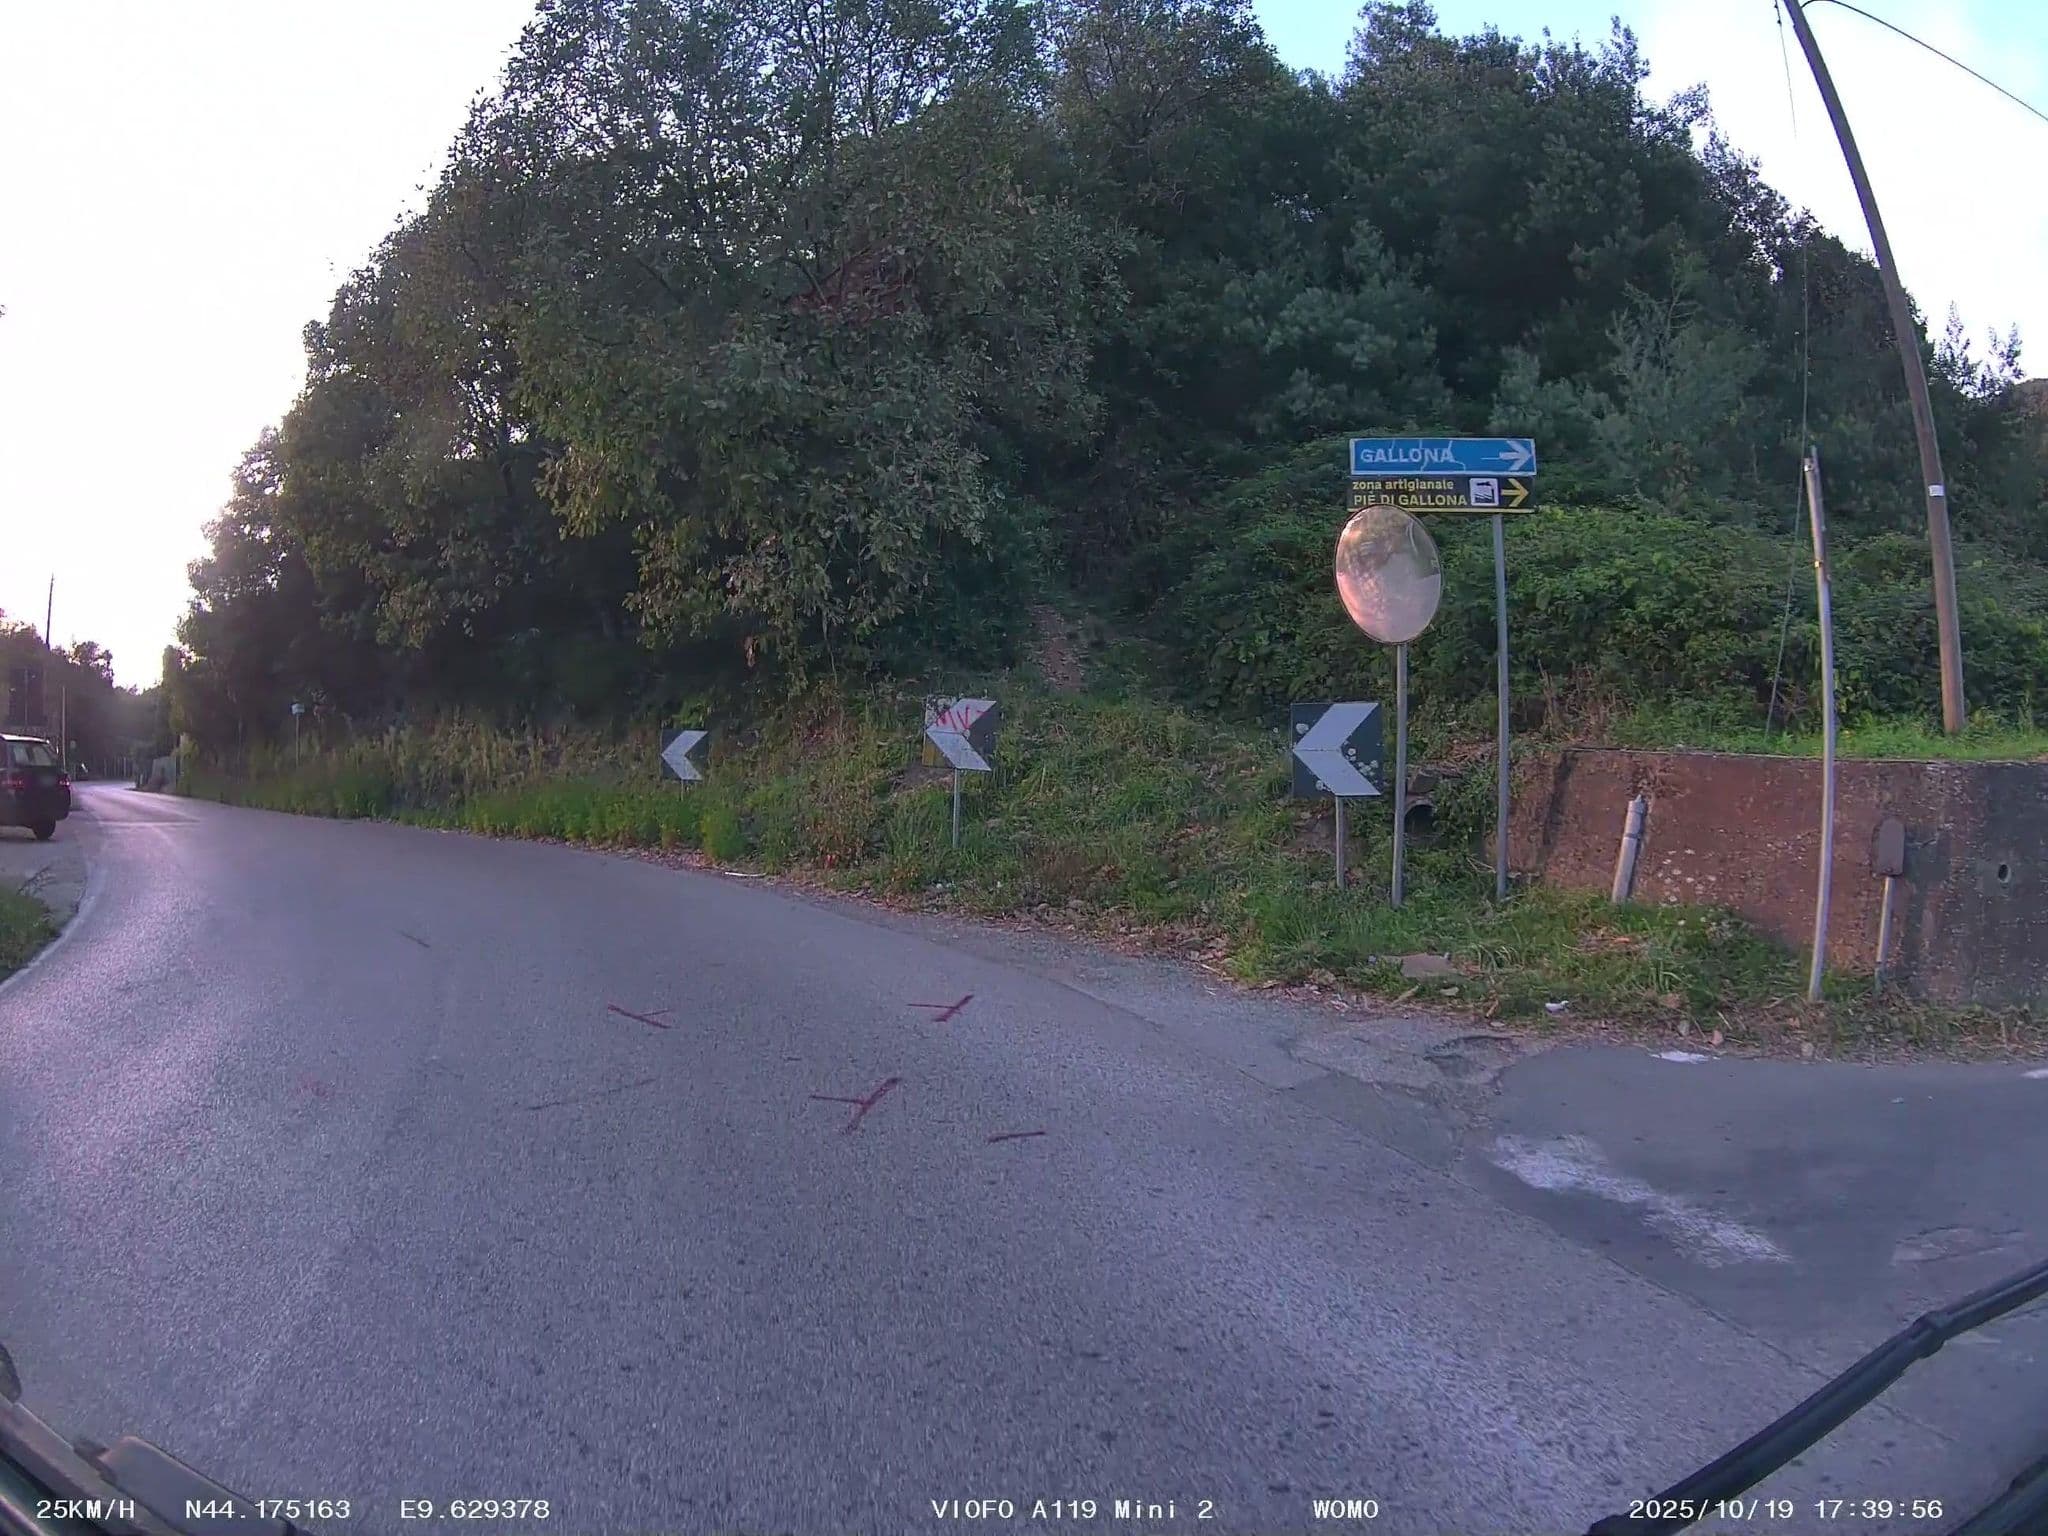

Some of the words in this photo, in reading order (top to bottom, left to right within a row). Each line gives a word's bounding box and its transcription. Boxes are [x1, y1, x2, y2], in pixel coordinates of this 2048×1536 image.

[1359, 446, 1455, 464] GALLONA
[1352, 480, 1382, 491] zona
[1385, 478, 1454, 492] artigianale
[1380, 494, 1394, 505] DI
[1398, 494, 1468, 506] GALLONA
